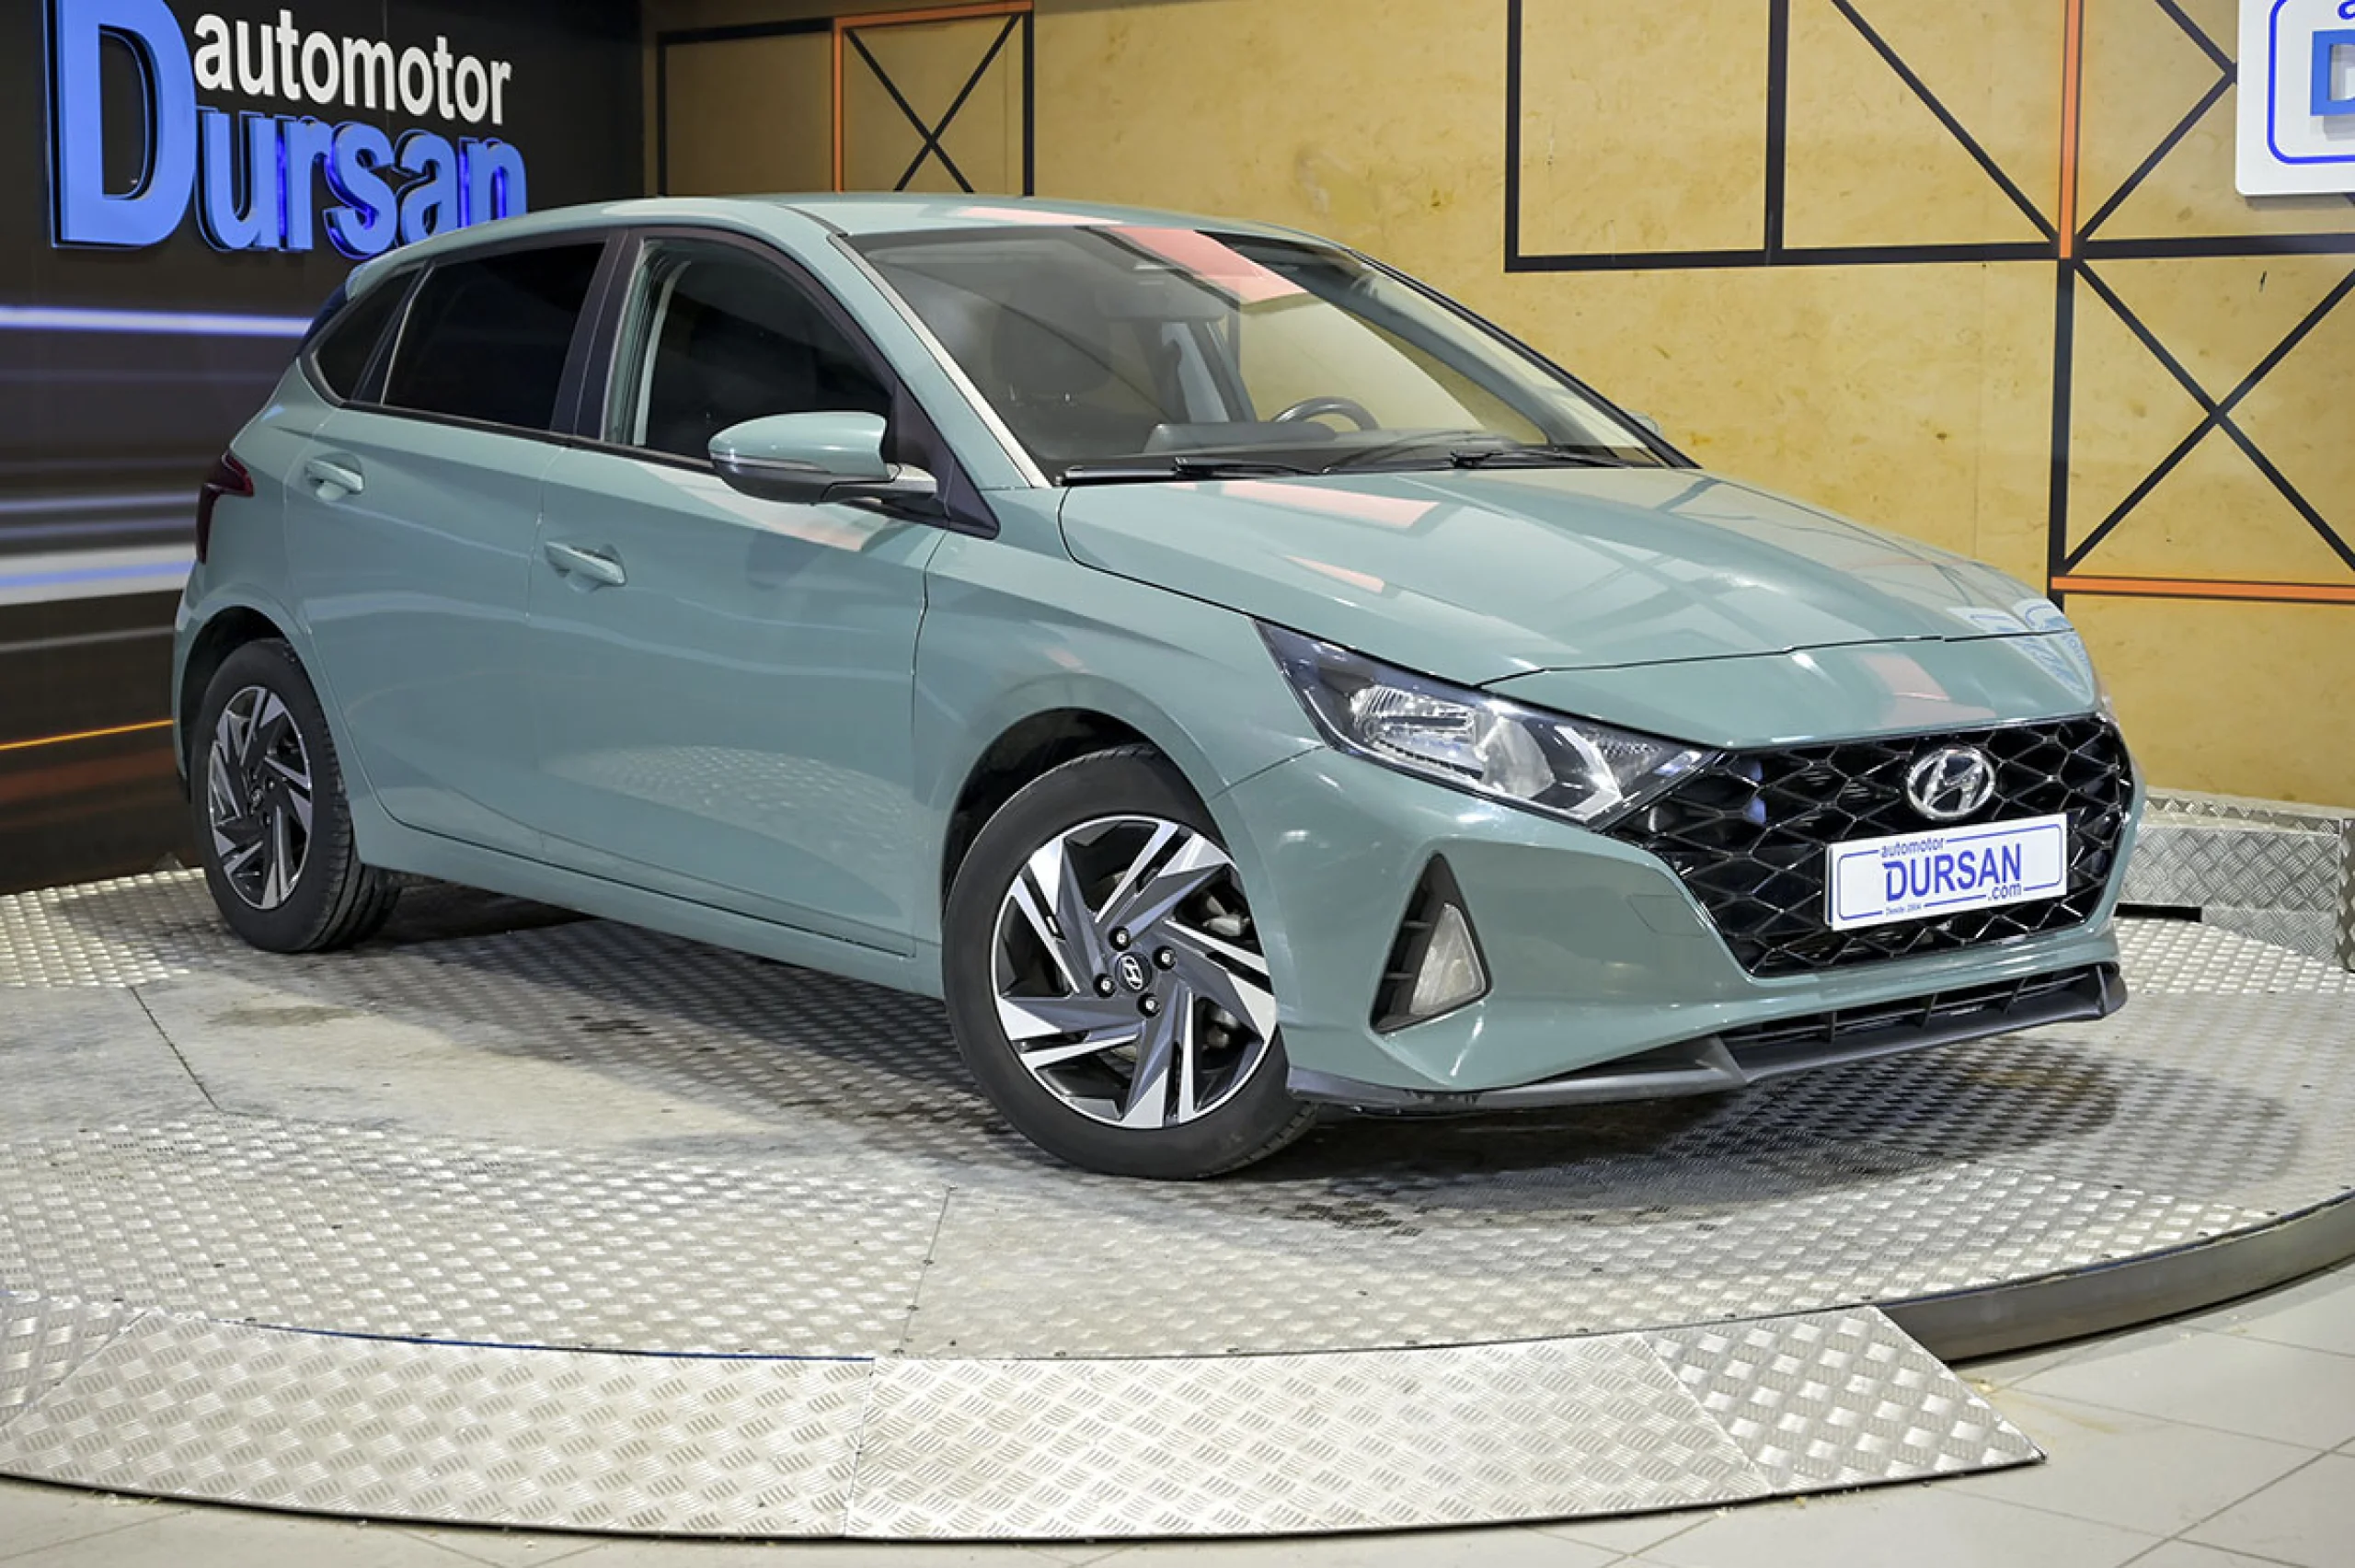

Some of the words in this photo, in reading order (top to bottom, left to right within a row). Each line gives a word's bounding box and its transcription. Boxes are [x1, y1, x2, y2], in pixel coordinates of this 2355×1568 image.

[193, 9, 512, 124] automotor
[48, 0, 528, 259] Dursan
[1881, 838, 1944, 858] automotor
[1882, 841, 2022, 902] DURSAN
[1987, 882, 2022, 901] .com
